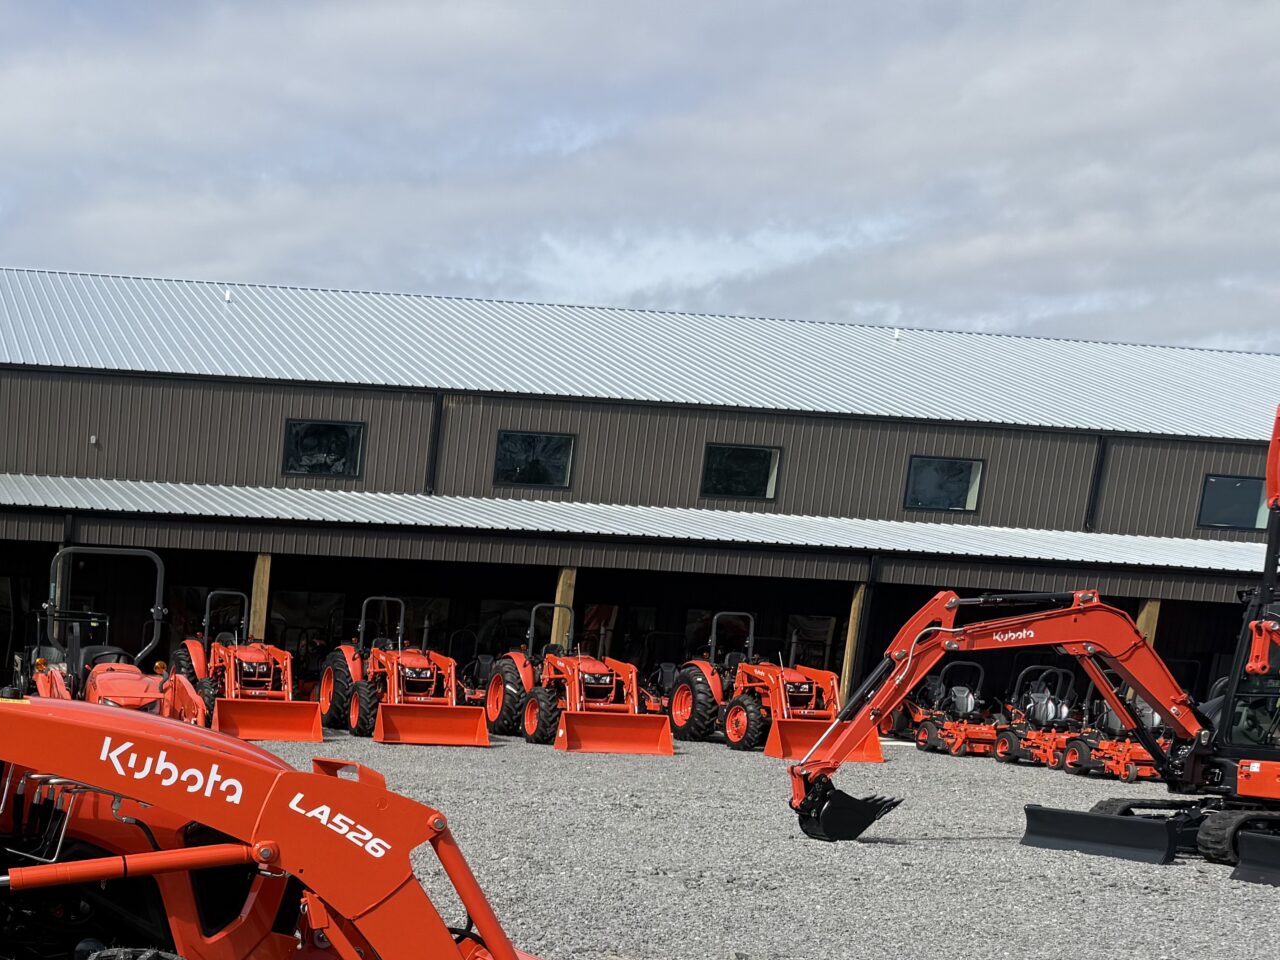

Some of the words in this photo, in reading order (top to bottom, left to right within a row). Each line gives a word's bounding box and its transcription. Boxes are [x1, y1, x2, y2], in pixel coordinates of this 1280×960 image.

[993, 628, 1034, 642] Kubota
[99, 736, 243, 805] Kubota
[288, 792, 392, 858] LA526
